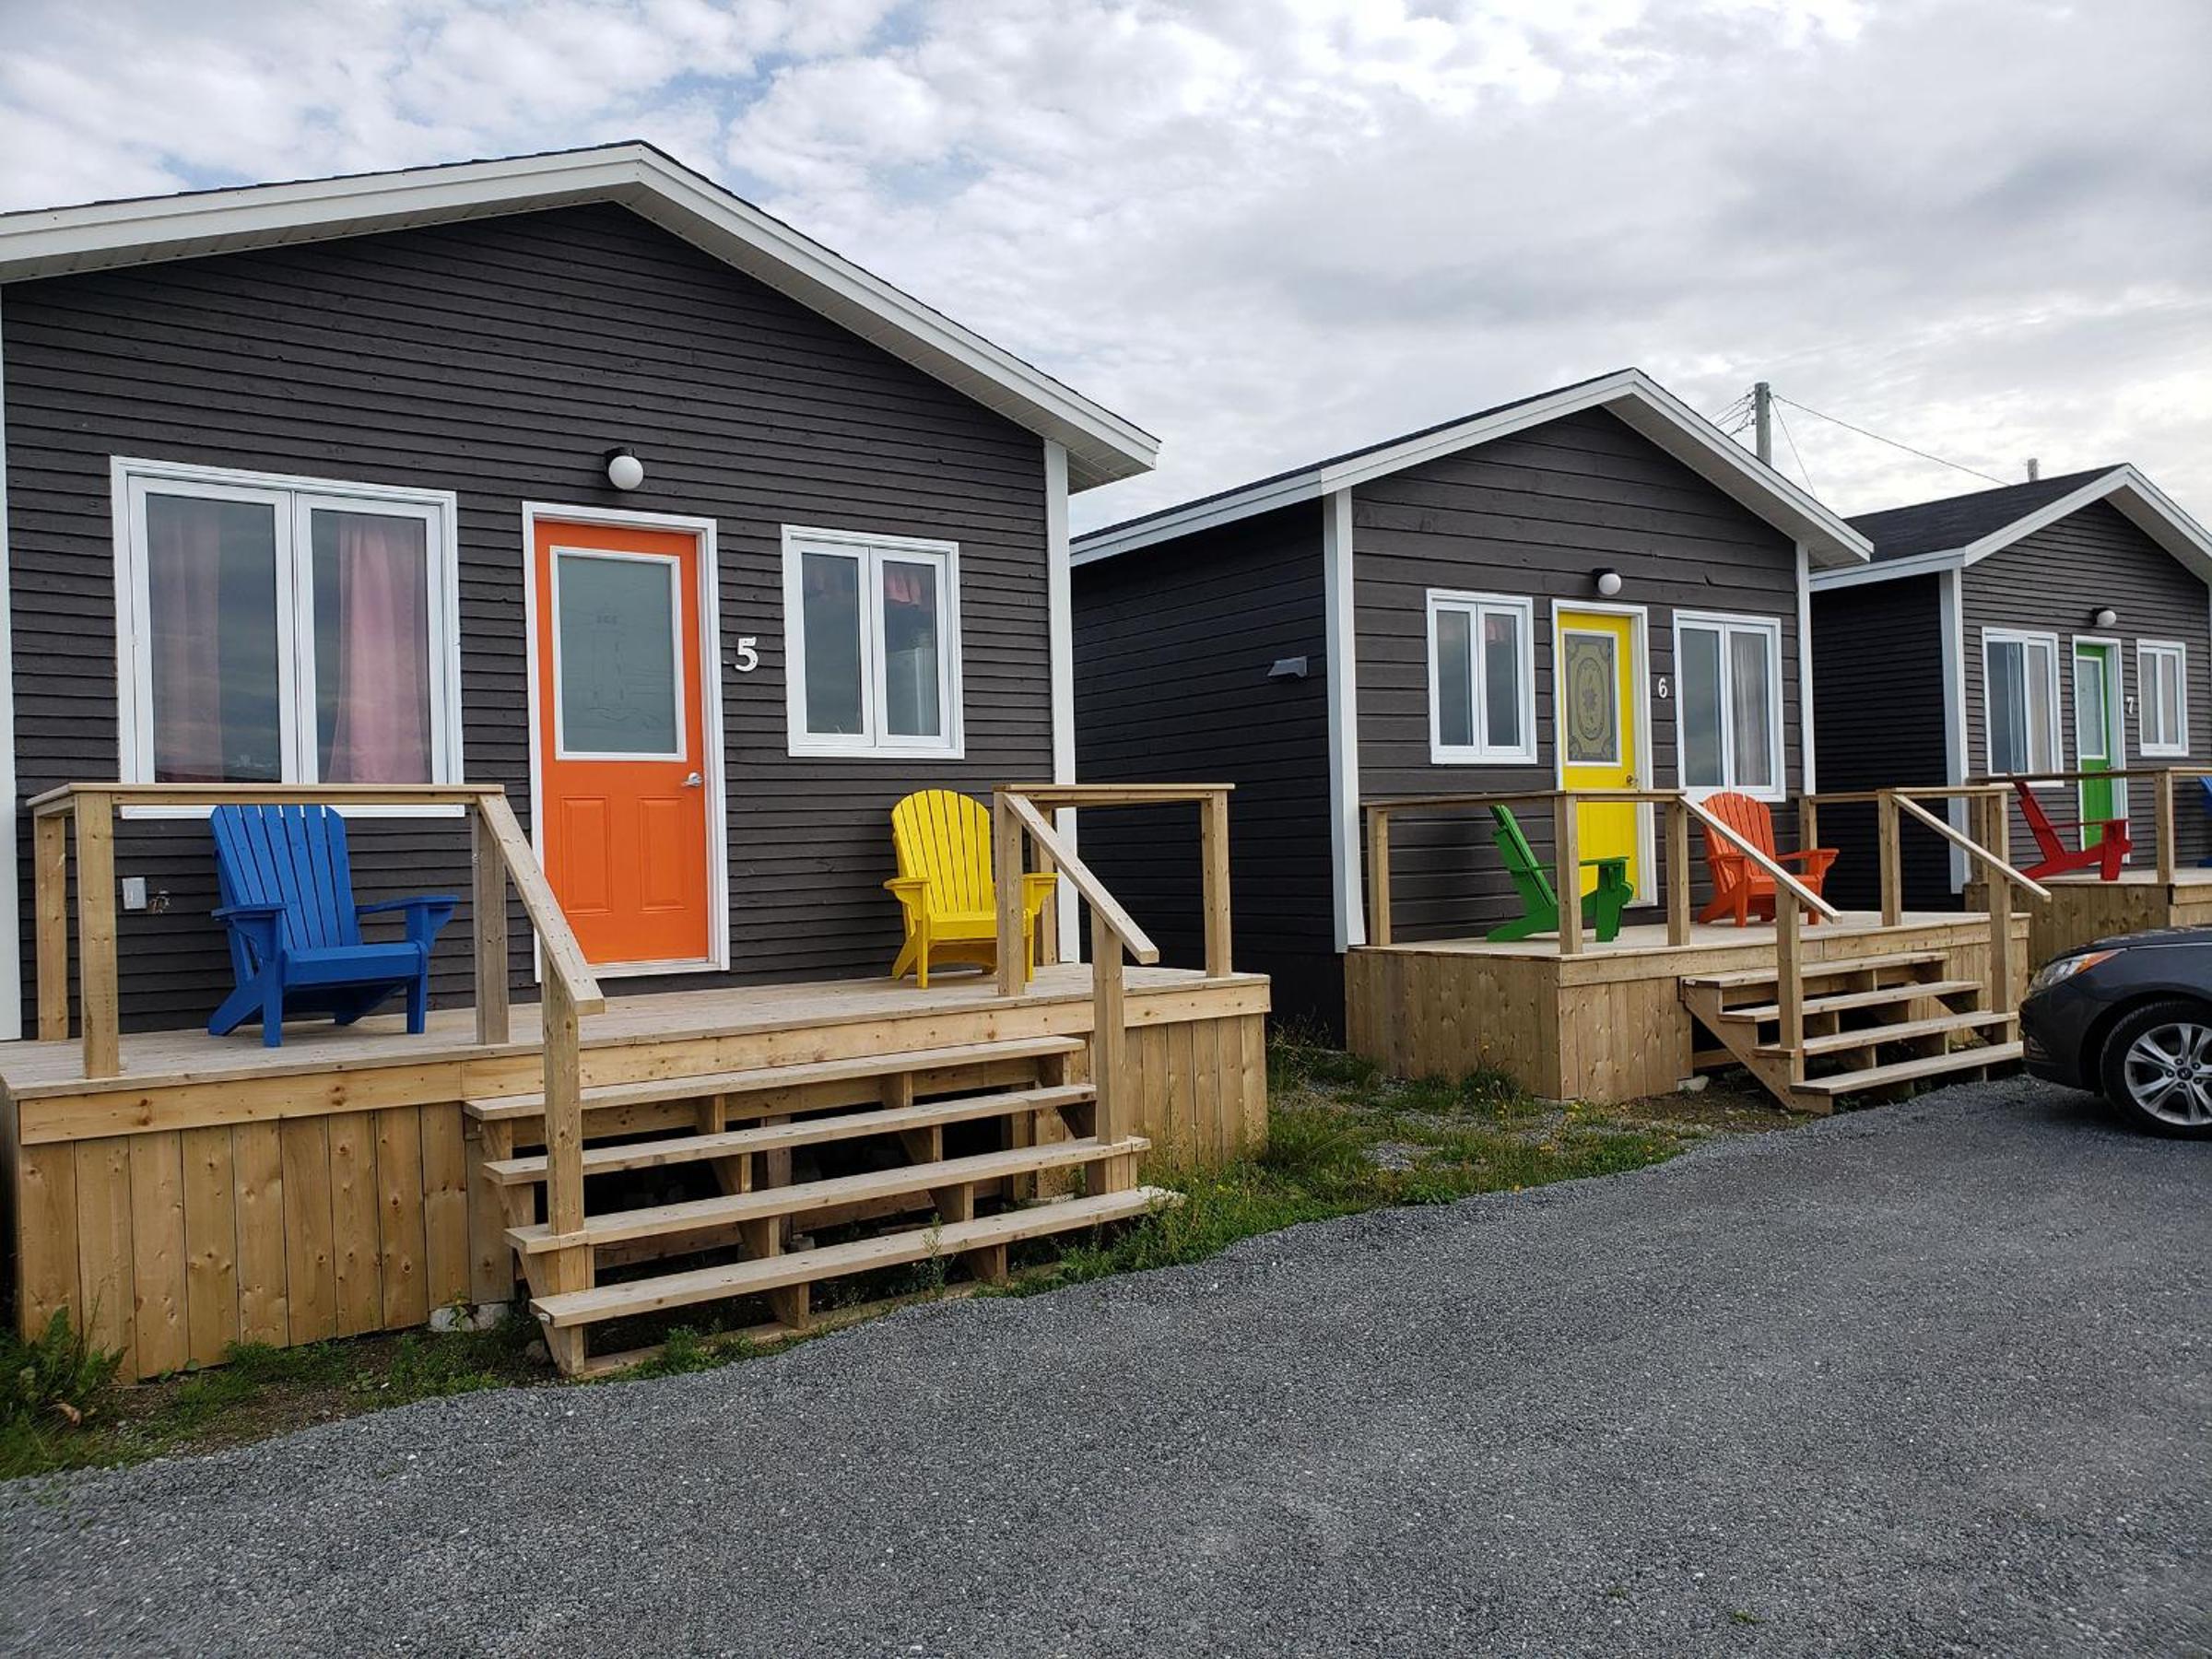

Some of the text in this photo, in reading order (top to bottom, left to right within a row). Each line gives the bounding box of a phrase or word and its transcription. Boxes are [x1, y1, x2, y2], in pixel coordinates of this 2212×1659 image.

[735, 636, 759, 672] 5
[1658, 677, 1667, 699] 6
[2126, 696, 2135, 714] 7
